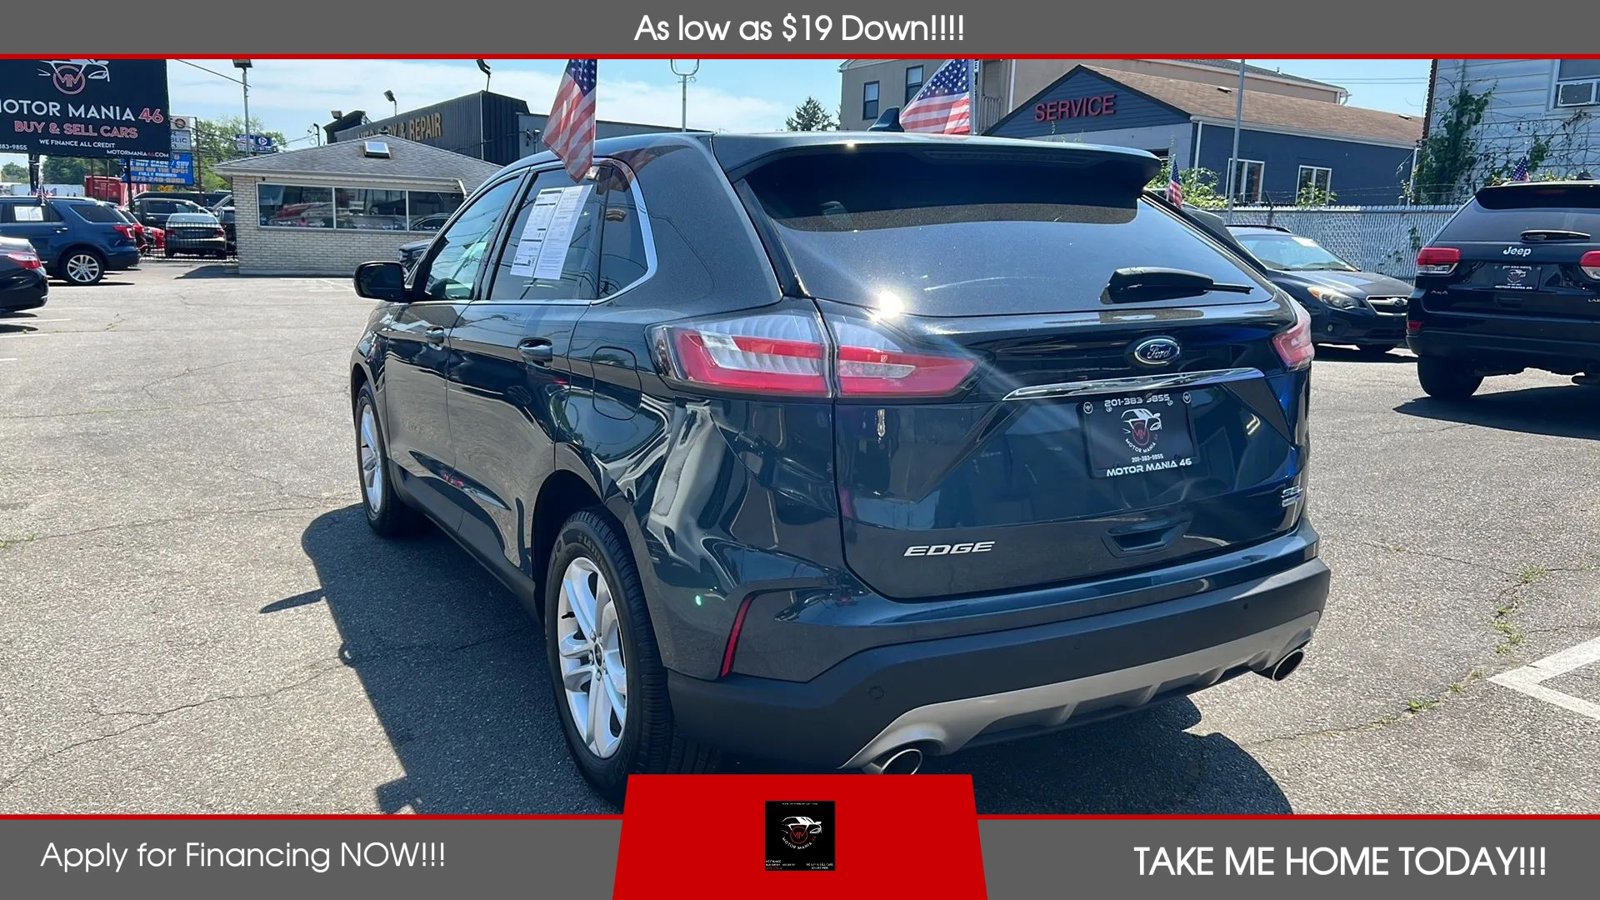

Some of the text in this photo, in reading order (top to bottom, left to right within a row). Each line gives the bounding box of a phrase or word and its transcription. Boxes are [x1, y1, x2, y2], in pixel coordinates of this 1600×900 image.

[0, 98, 164, 124] OTOR MANIA 46
[1034, 94, 1116, 122] SERVICE
[14, 120, 138, 139] BUY & SELL CARS
[410, 112, 442, 141] REPAIR
[50, 139, 79, 147] FINANCE
[93, 141, 116, 149] CREDIT
[1503, 246, 1532, 257] Jeep
[1147, 344, 1172, 359] Ford
[1125, 438, 1157, 453] MOTOR MANIA
[1106, 458, 1193, 477] MOTOR MANIA 46
[903, 541, 996, 557] EDGE
